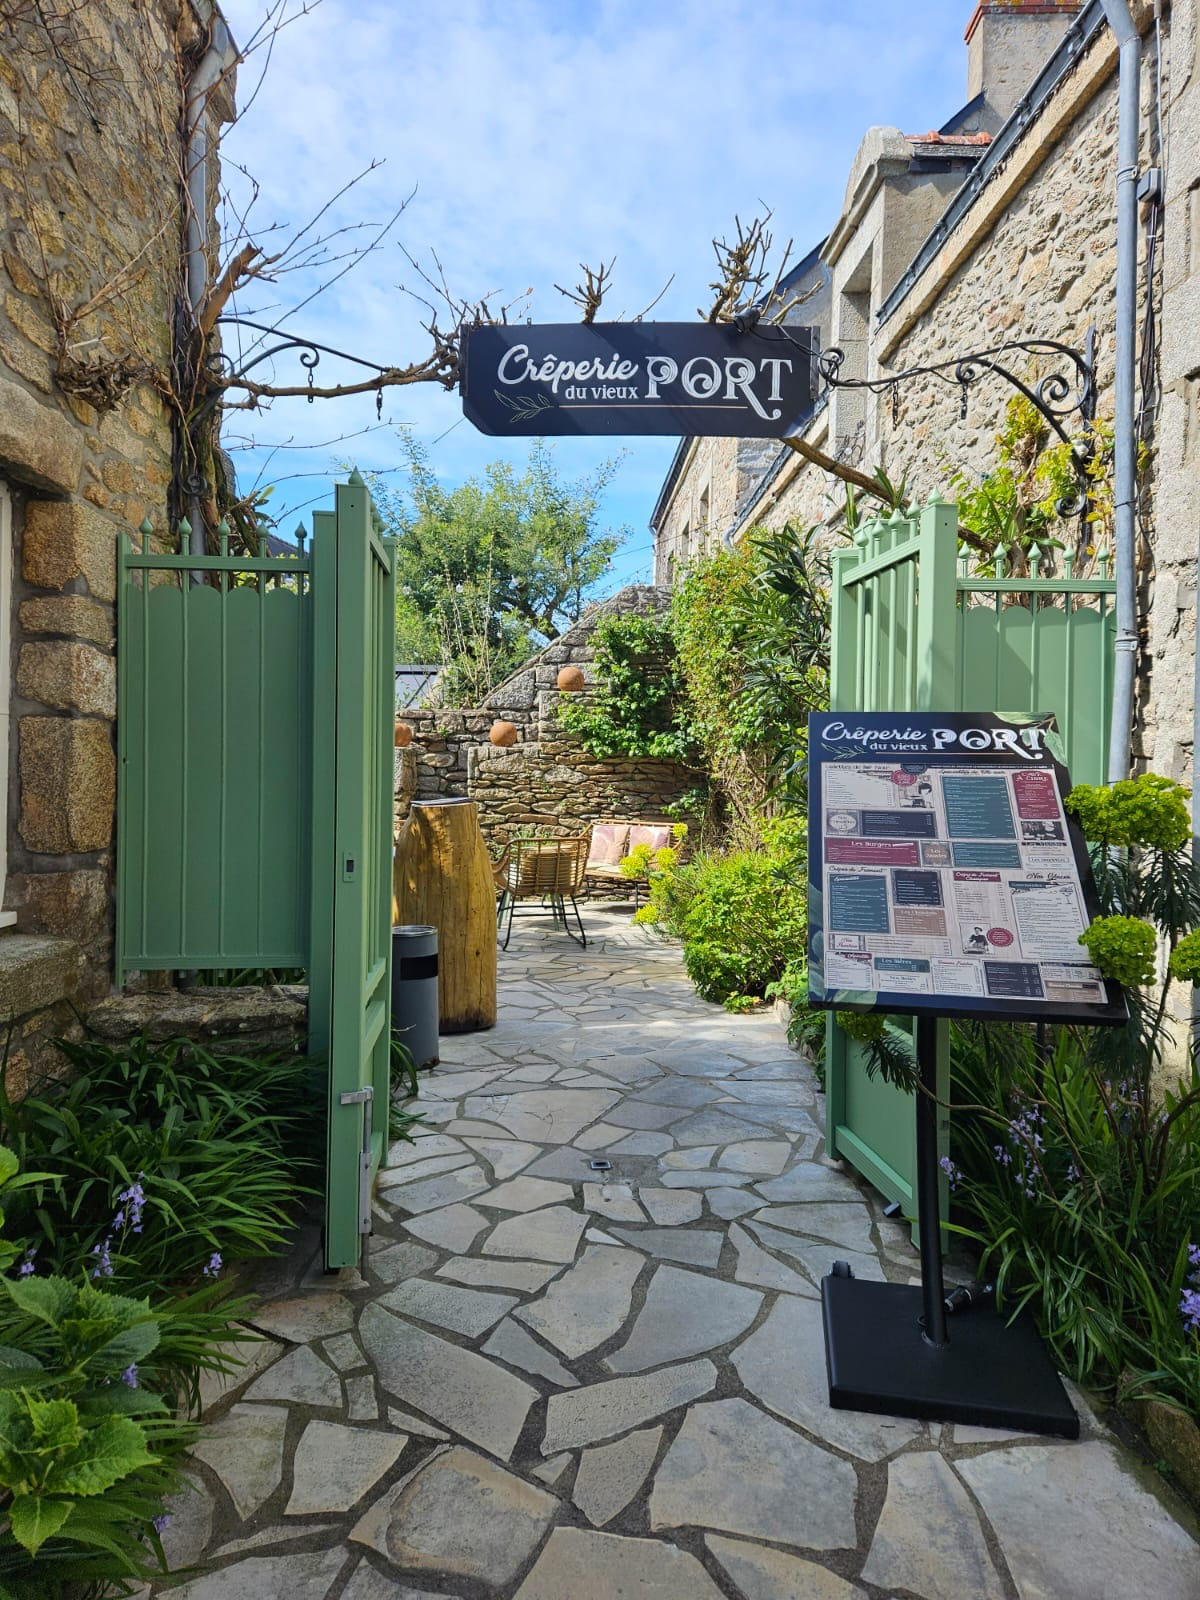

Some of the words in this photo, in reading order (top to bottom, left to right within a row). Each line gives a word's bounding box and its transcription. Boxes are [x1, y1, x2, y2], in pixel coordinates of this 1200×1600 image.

[497, 344, 639, 393] Crêperie
[565, 385, 589, 400] du
[591, 386, 639, 400] vieux
[645, 356, 793, 421] PORT
[822, 722, 926, 746] Crêperie
[869, 742, 887, 751] du
[890, 743, 928, 751] vieux
[930, 728, 1047, 760] PORT
